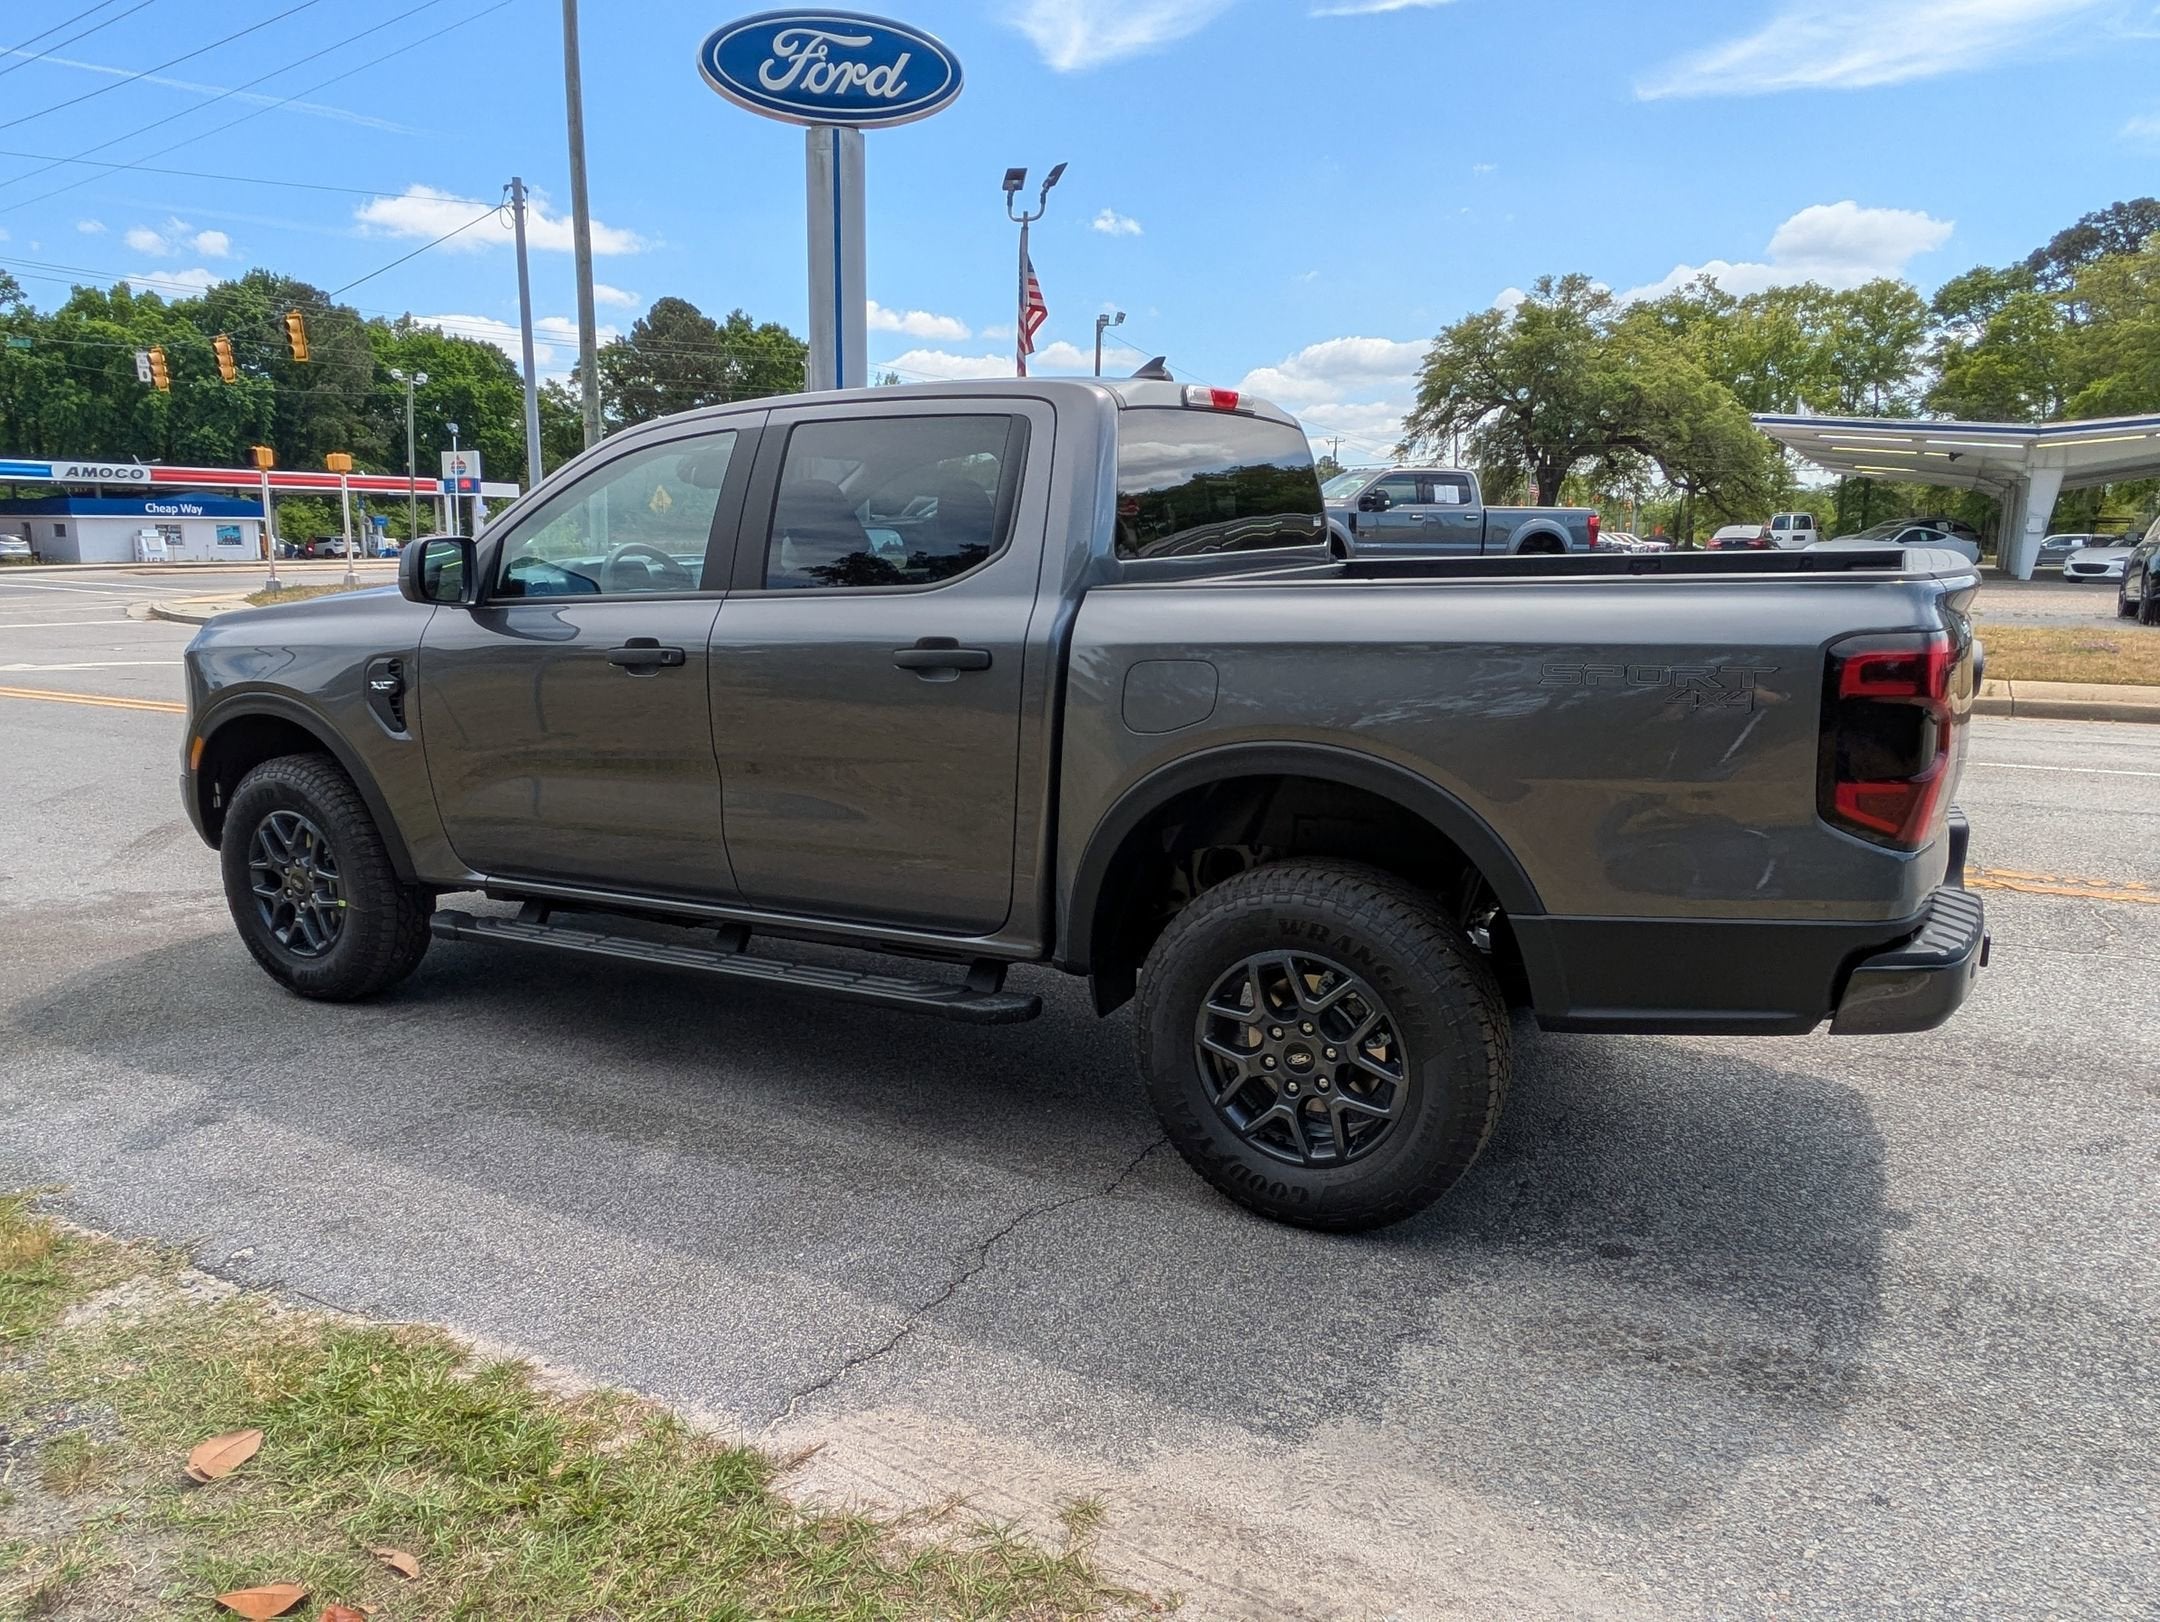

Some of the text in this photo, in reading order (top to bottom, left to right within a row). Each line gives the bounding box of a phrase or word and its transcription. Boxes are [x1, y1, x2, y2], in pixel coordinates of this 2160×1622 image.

[758, 28, 911, 98] Ford
[65, 466, 144, 479] AMOCO
[145, 502, 203, 515] Cheap Way
[1538, 663, 1779, 689] SPORT
